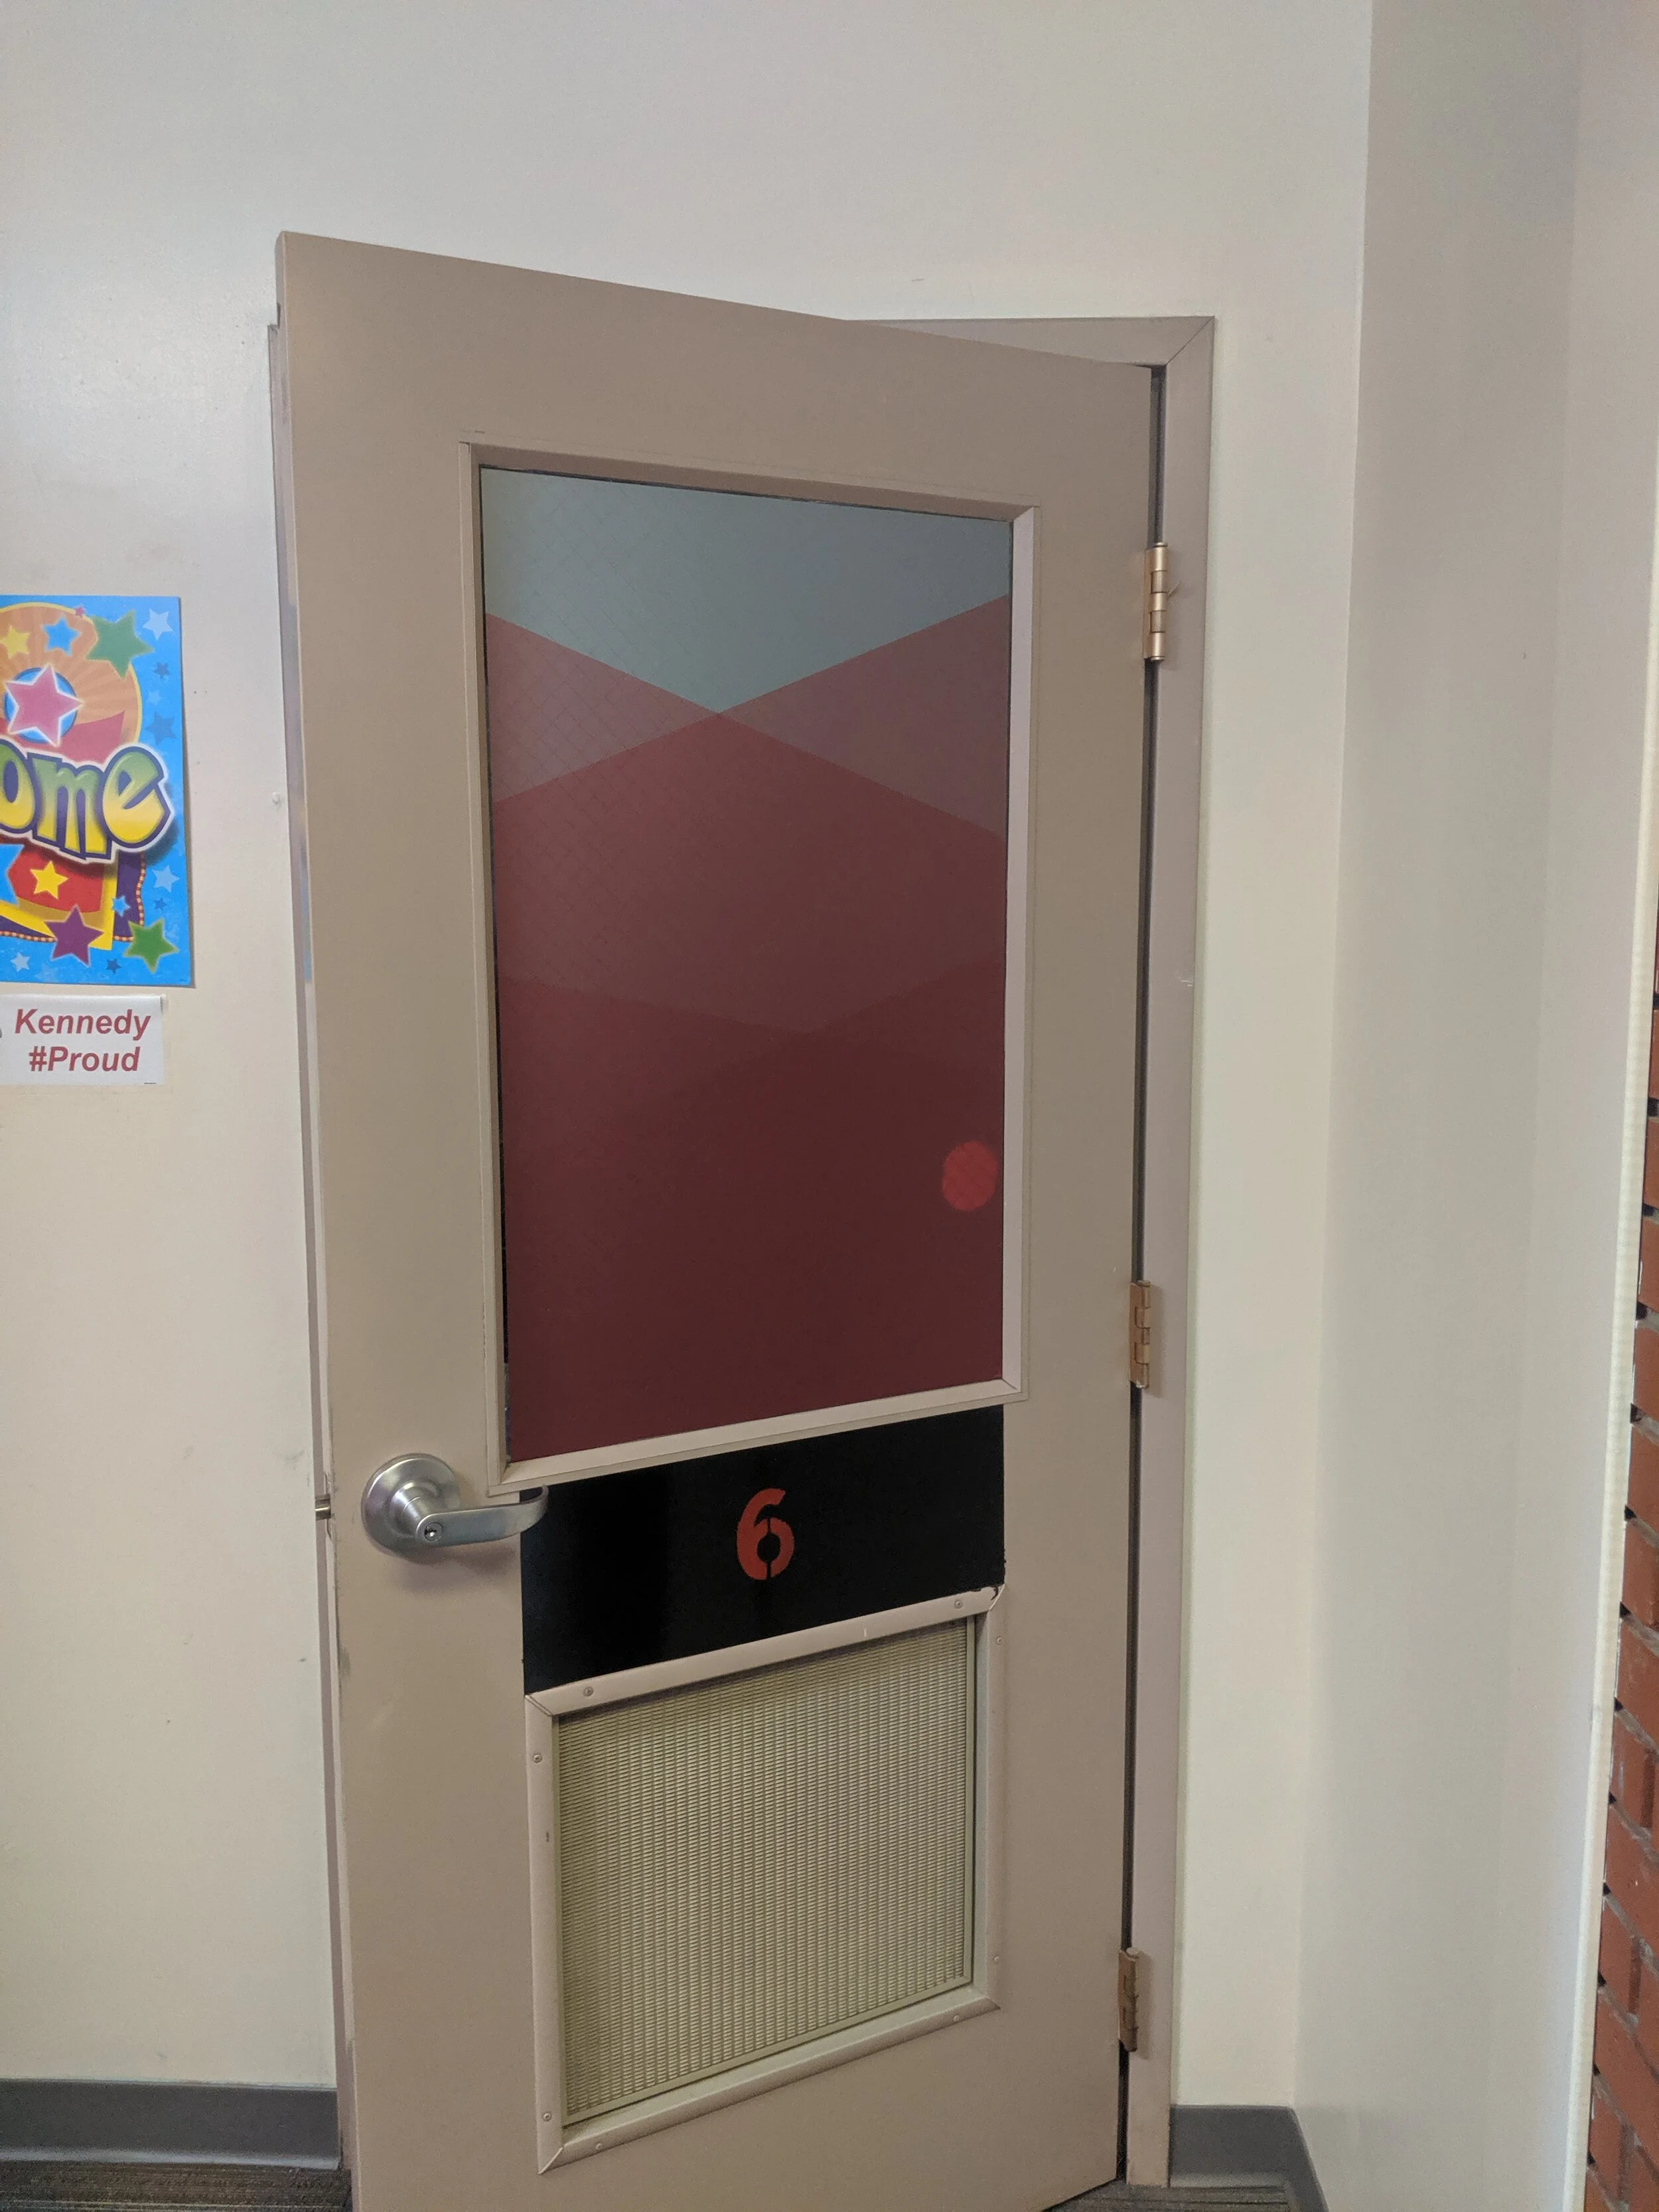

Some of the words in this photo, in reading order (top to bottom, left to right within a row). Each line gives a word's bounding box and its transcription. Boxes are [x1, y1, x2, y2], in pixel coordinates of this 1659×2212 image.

[15, 1008, 151, 1041] Kennedy
[29, 1046, 141, 1072] #Proud
[737, 1488, 795, 1580] 6
